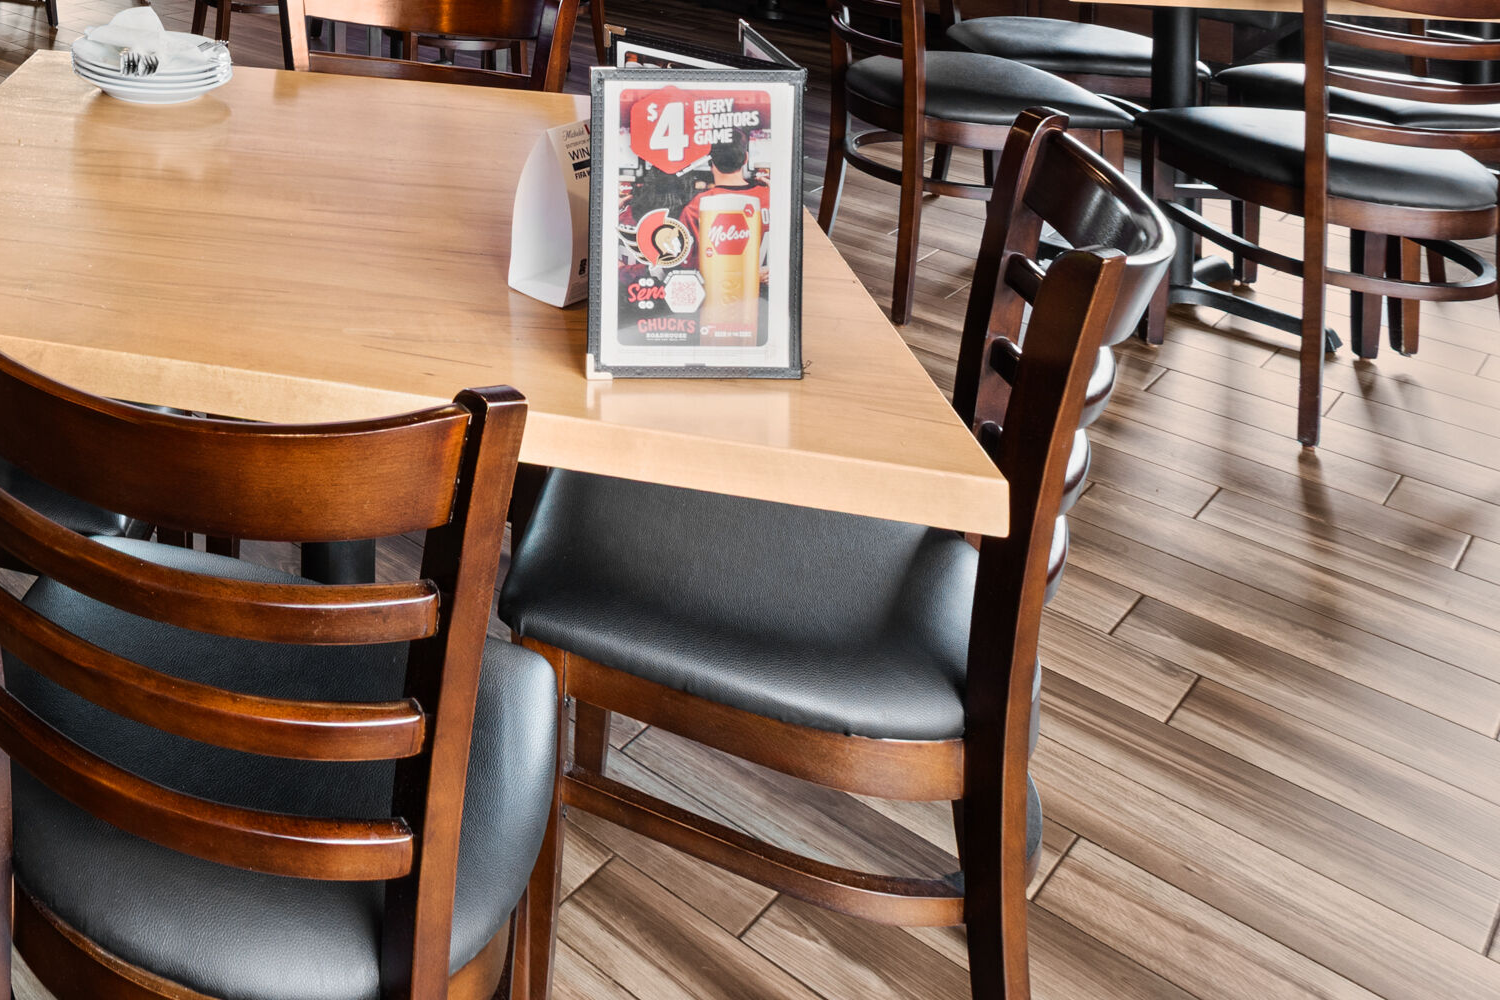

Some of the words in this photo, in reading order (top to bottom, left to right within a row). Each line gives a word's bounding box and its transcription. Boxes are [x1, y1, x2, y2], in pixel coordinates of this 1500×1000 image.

[694, 98, 734, 114] EVERY
[694, 111, 760, 130] SENATORS
[694, 129, 733, 145] GAME
[568, 147, 590, 160] WIN
[575, 170, 587, 180] FIFA
[708, 225, 751, 246] Molson
[638, 278, 654, 286] GO
[628, 284, 666, 303] Sens
[638, 301, 654, 309] GO
